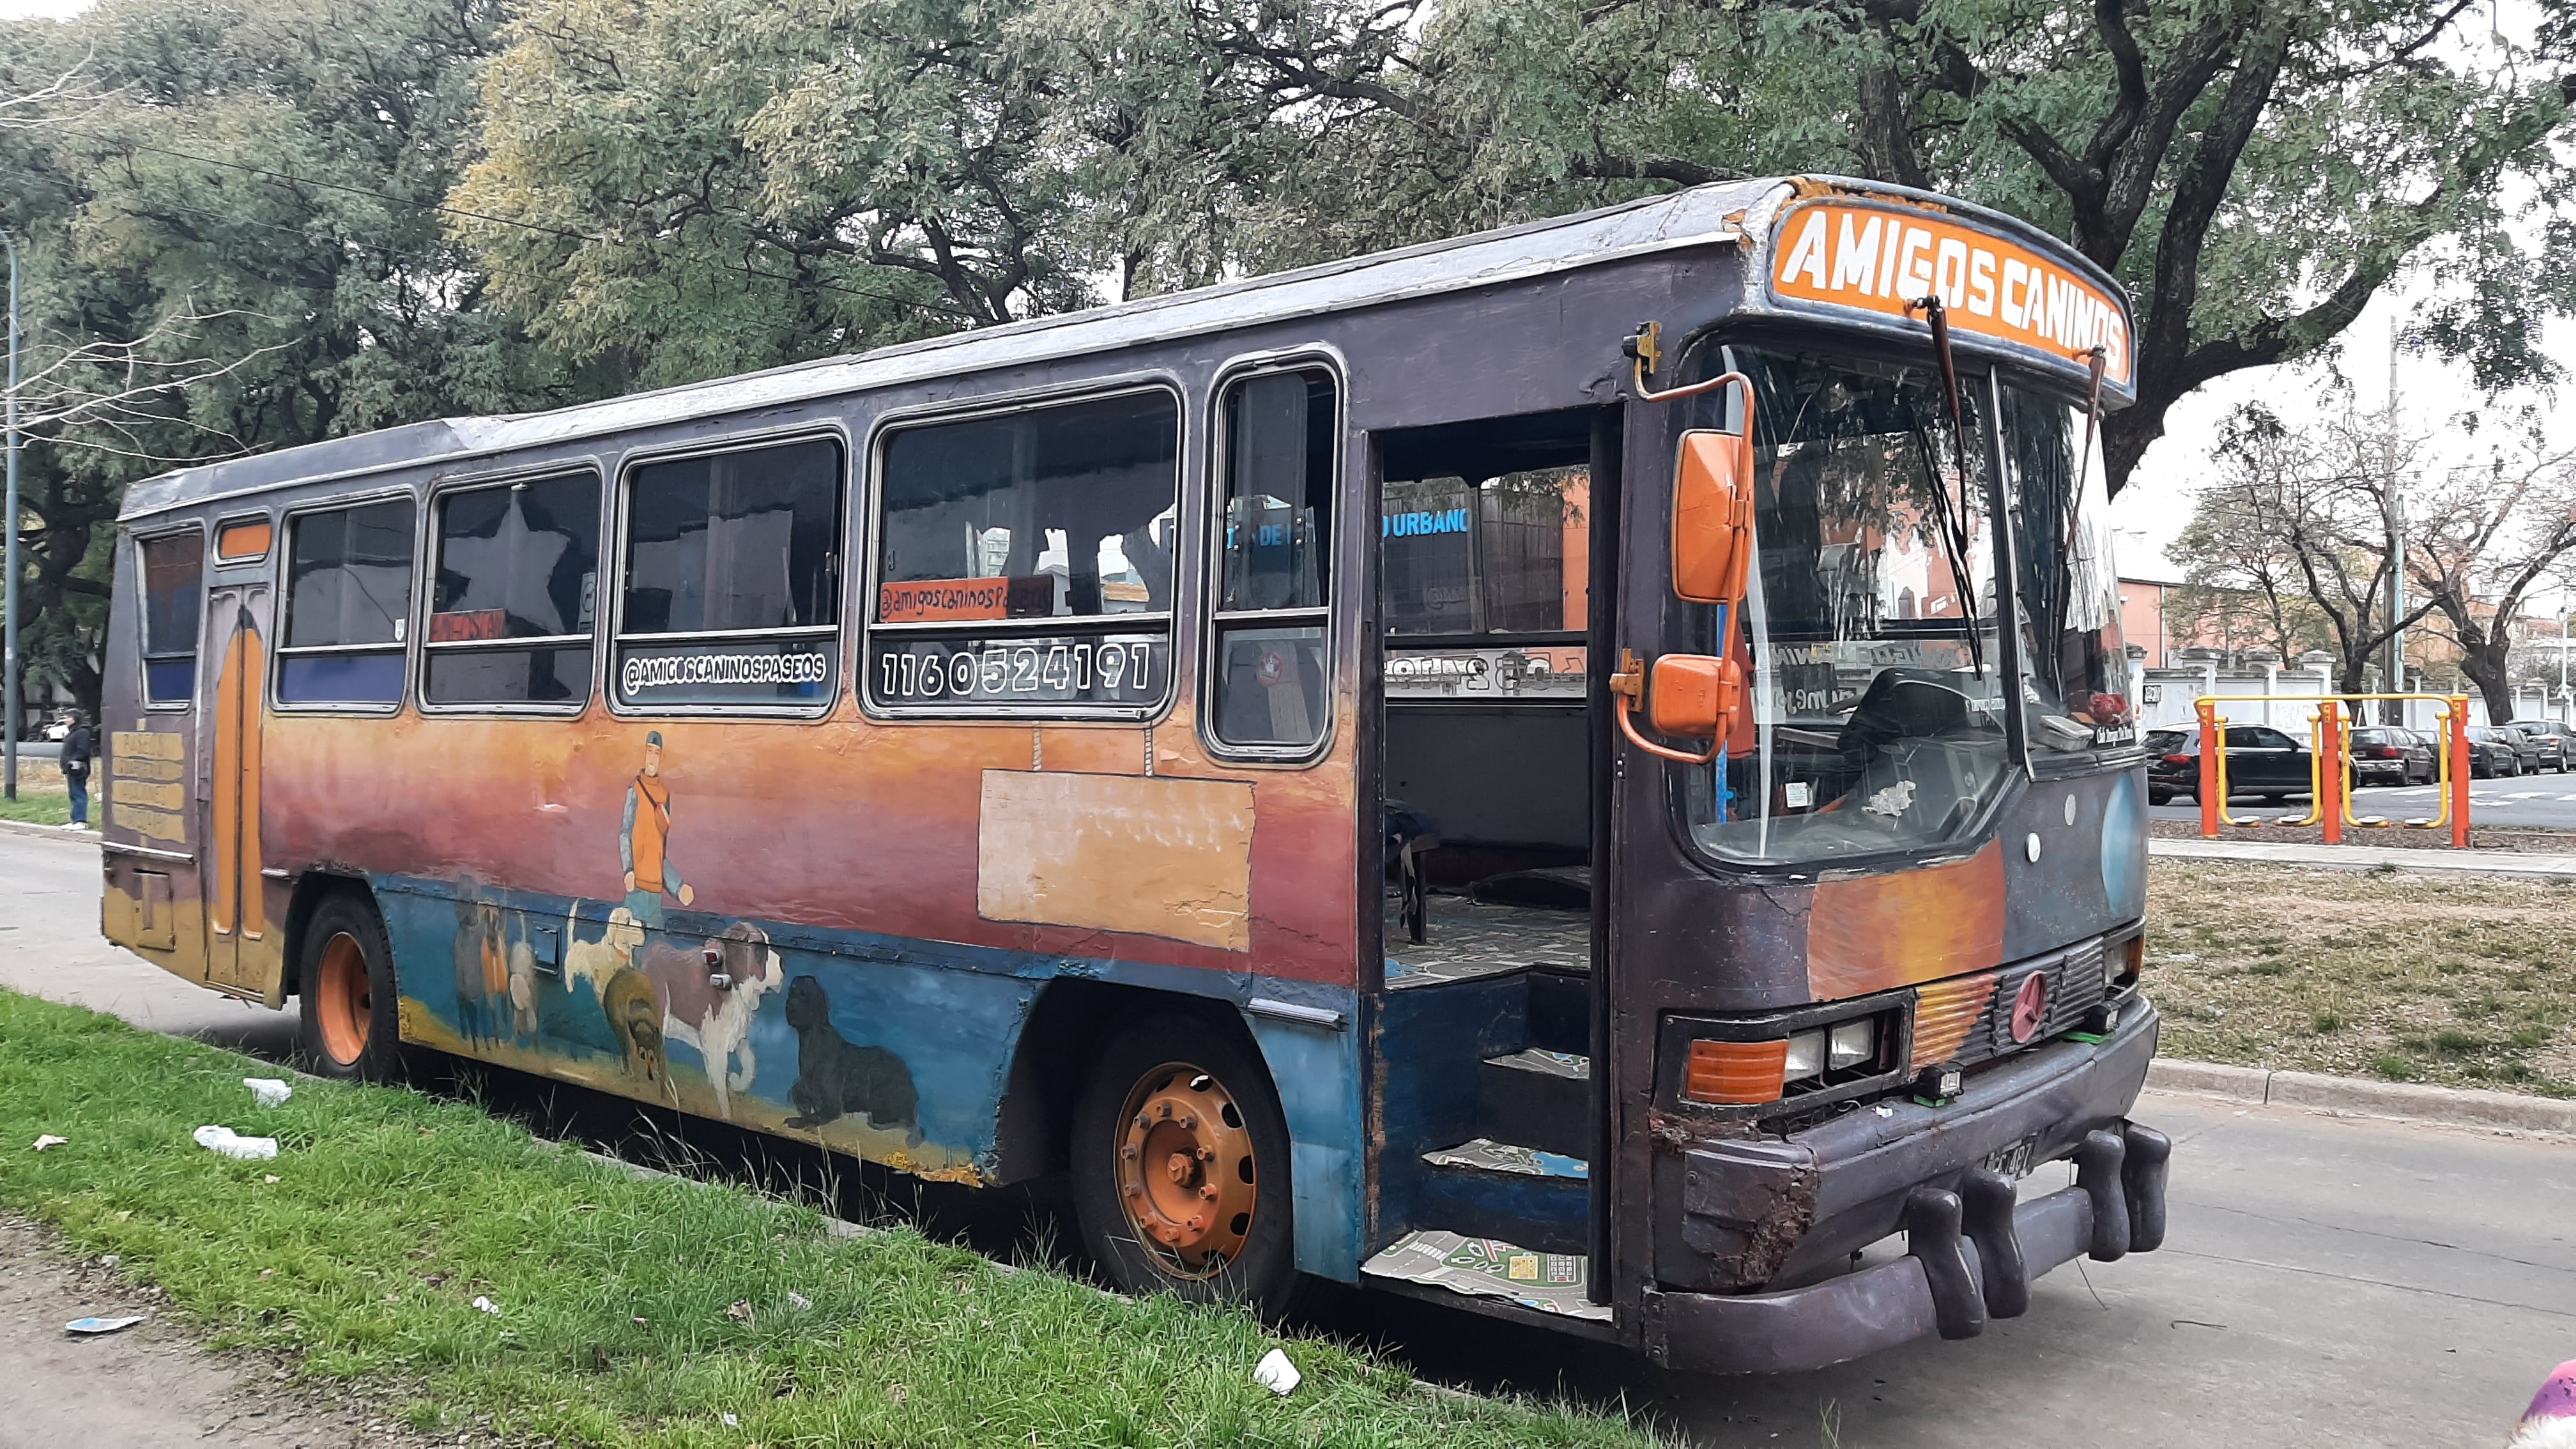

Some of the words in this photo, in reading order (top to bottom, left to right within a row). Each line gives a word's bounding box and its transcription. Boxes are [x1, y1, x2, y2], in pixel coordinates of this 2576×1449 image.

[1781, 210, 1997, 318] AMIGOS
[2000, 257, 2123, 372] CANINOS
[623, 652, 827, 696] @AMIGOSCANINOSPASEOS
[882, 643, 1150, 697] 1160524191
